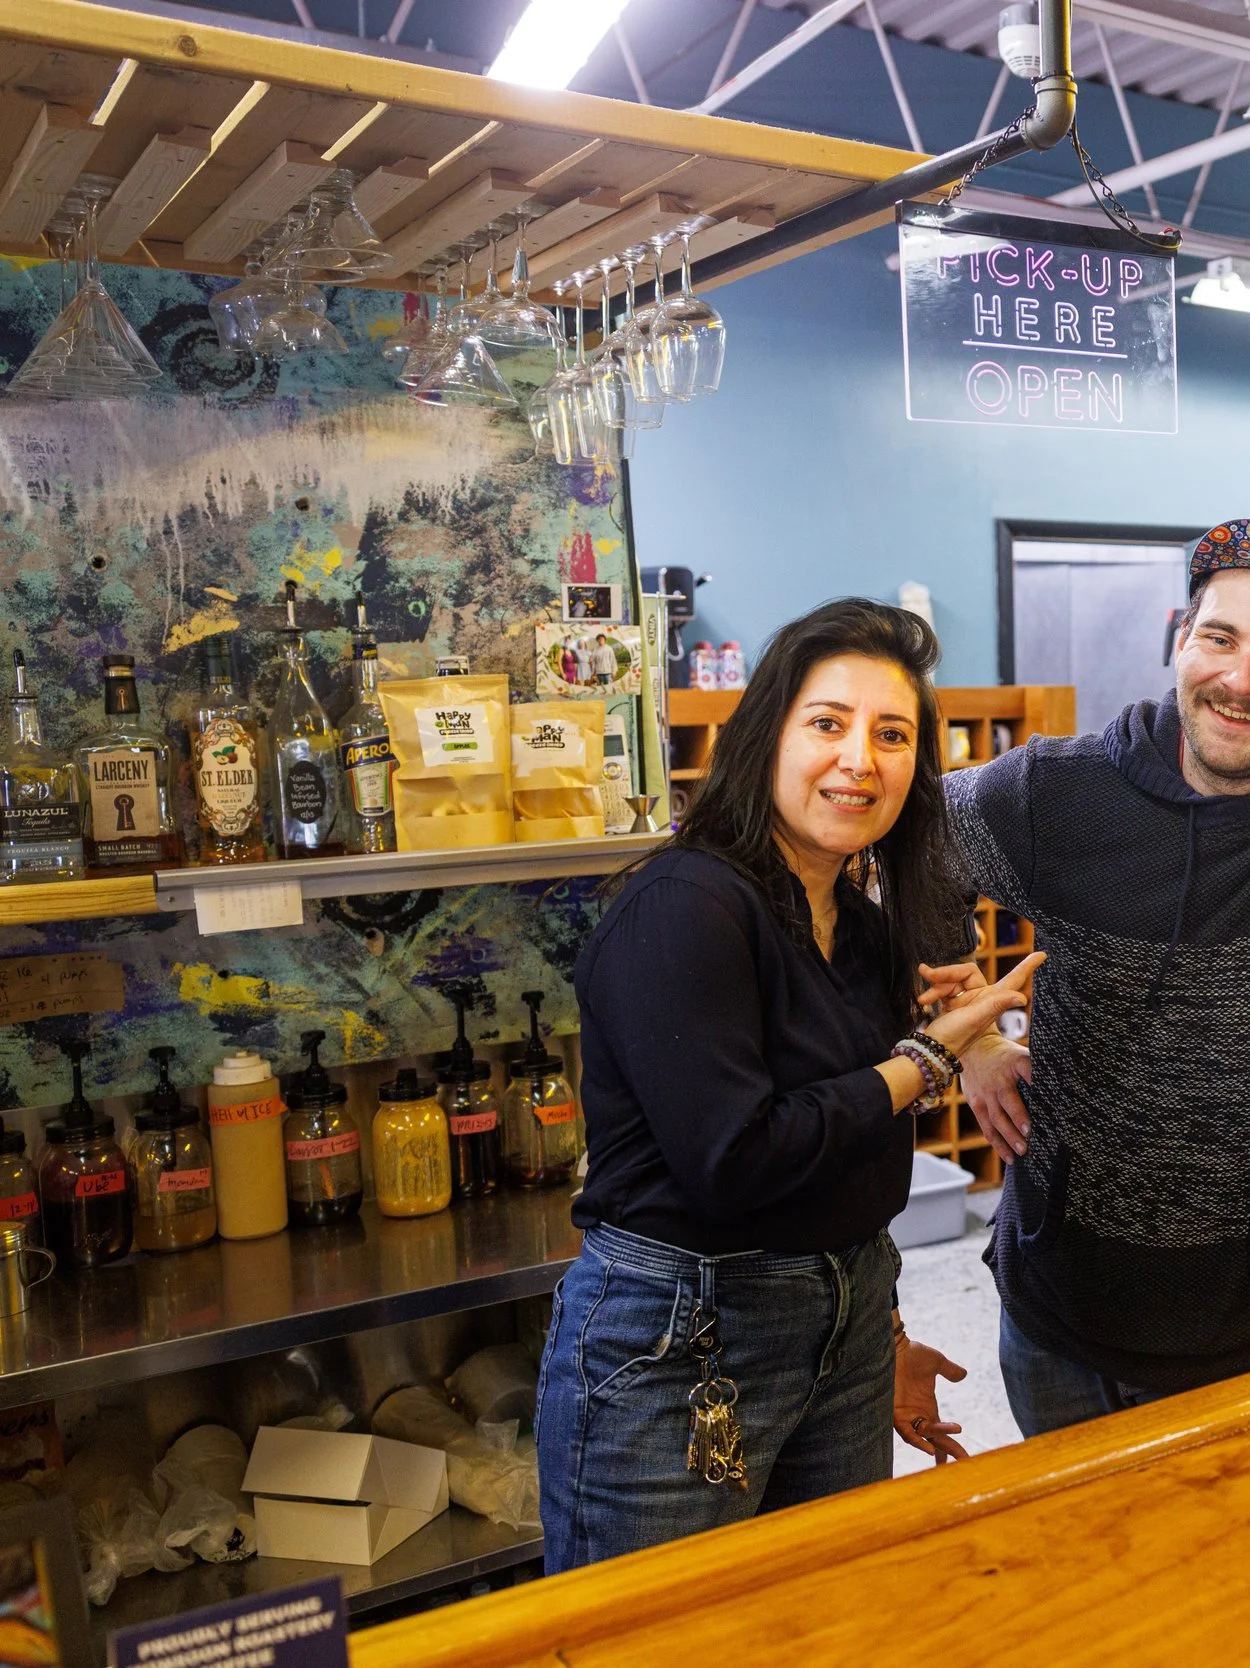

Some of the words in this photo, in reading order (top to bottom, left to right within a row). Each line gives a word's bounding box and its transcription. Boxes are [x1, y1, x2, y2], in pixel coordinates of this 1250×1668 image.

[937, 238, 1143, 299] PICK-UP
[973, 293, 1117, 347] HERE
[966, 360, 1124, 423] OPEN
[346, 742, 389, 766] APERO
[93, 759, 149, 782] LARCENY
[201, 770, 216, 786] ST.
[217, 768, 254, 786] ELDER
[292, 783, 316, 792] Bean
[3, 807, 69, 818] LUNAZUL
[291, 799, 322, 810] Bourbon
[249, 1101, 273, 1119] ICE
[82, 1176, 110, 1193] Ube
